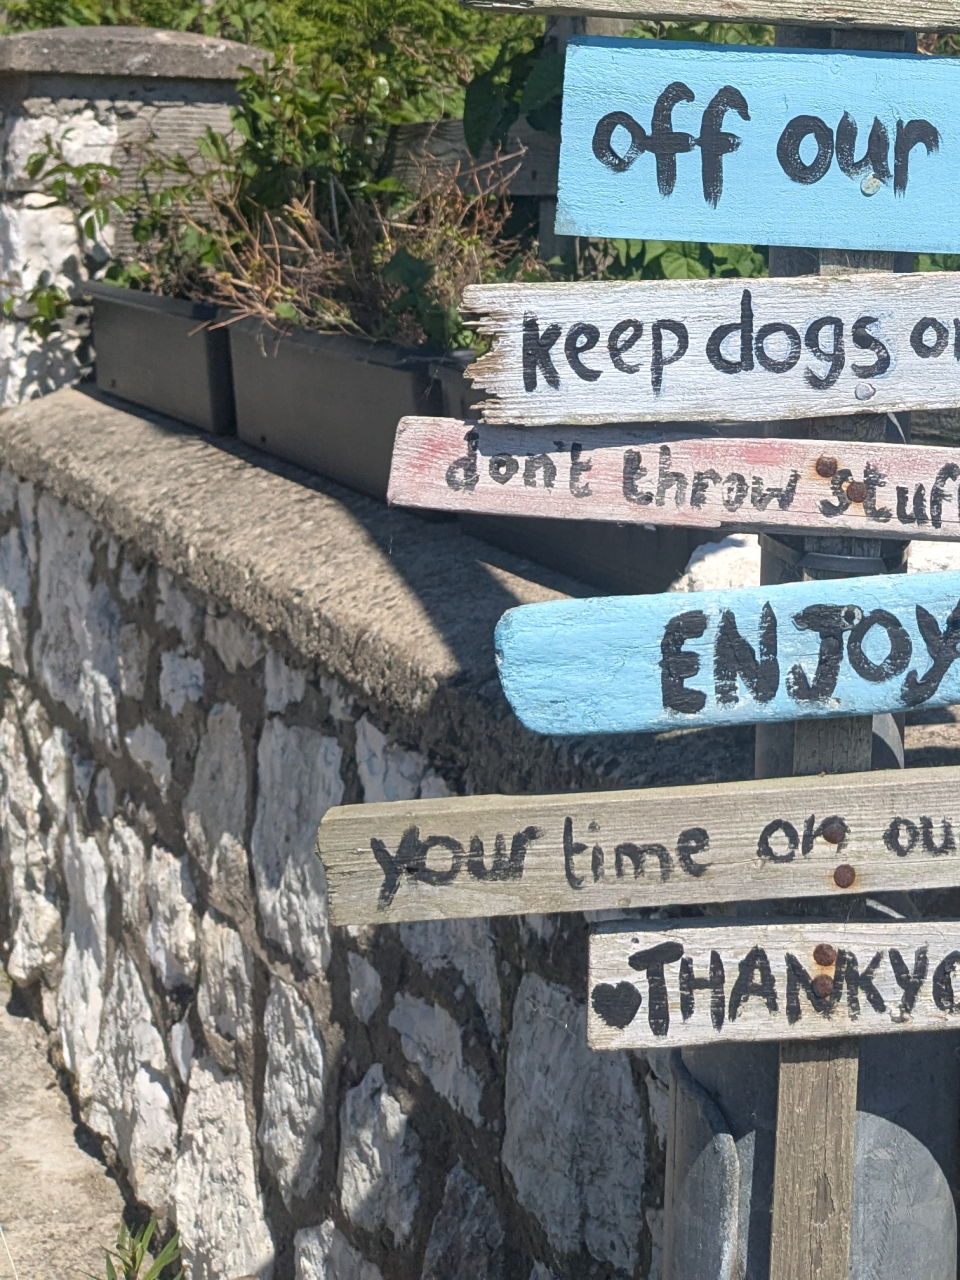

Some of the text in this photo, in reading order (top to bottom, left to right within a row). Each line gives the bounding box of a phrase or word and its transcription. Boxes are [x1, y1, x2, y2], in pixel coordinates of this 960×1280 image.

[592, 81, 751, 209] off
[776, 109, 943, 200] our
[522, 310, 689, 395] keep
[705, 288, 893, 390] dogs
[622, 444, 801, 511] throw
[369, 824, 544, 911] your
[563, 815, 711, 891] time
[756, 814, 851, 865] on
